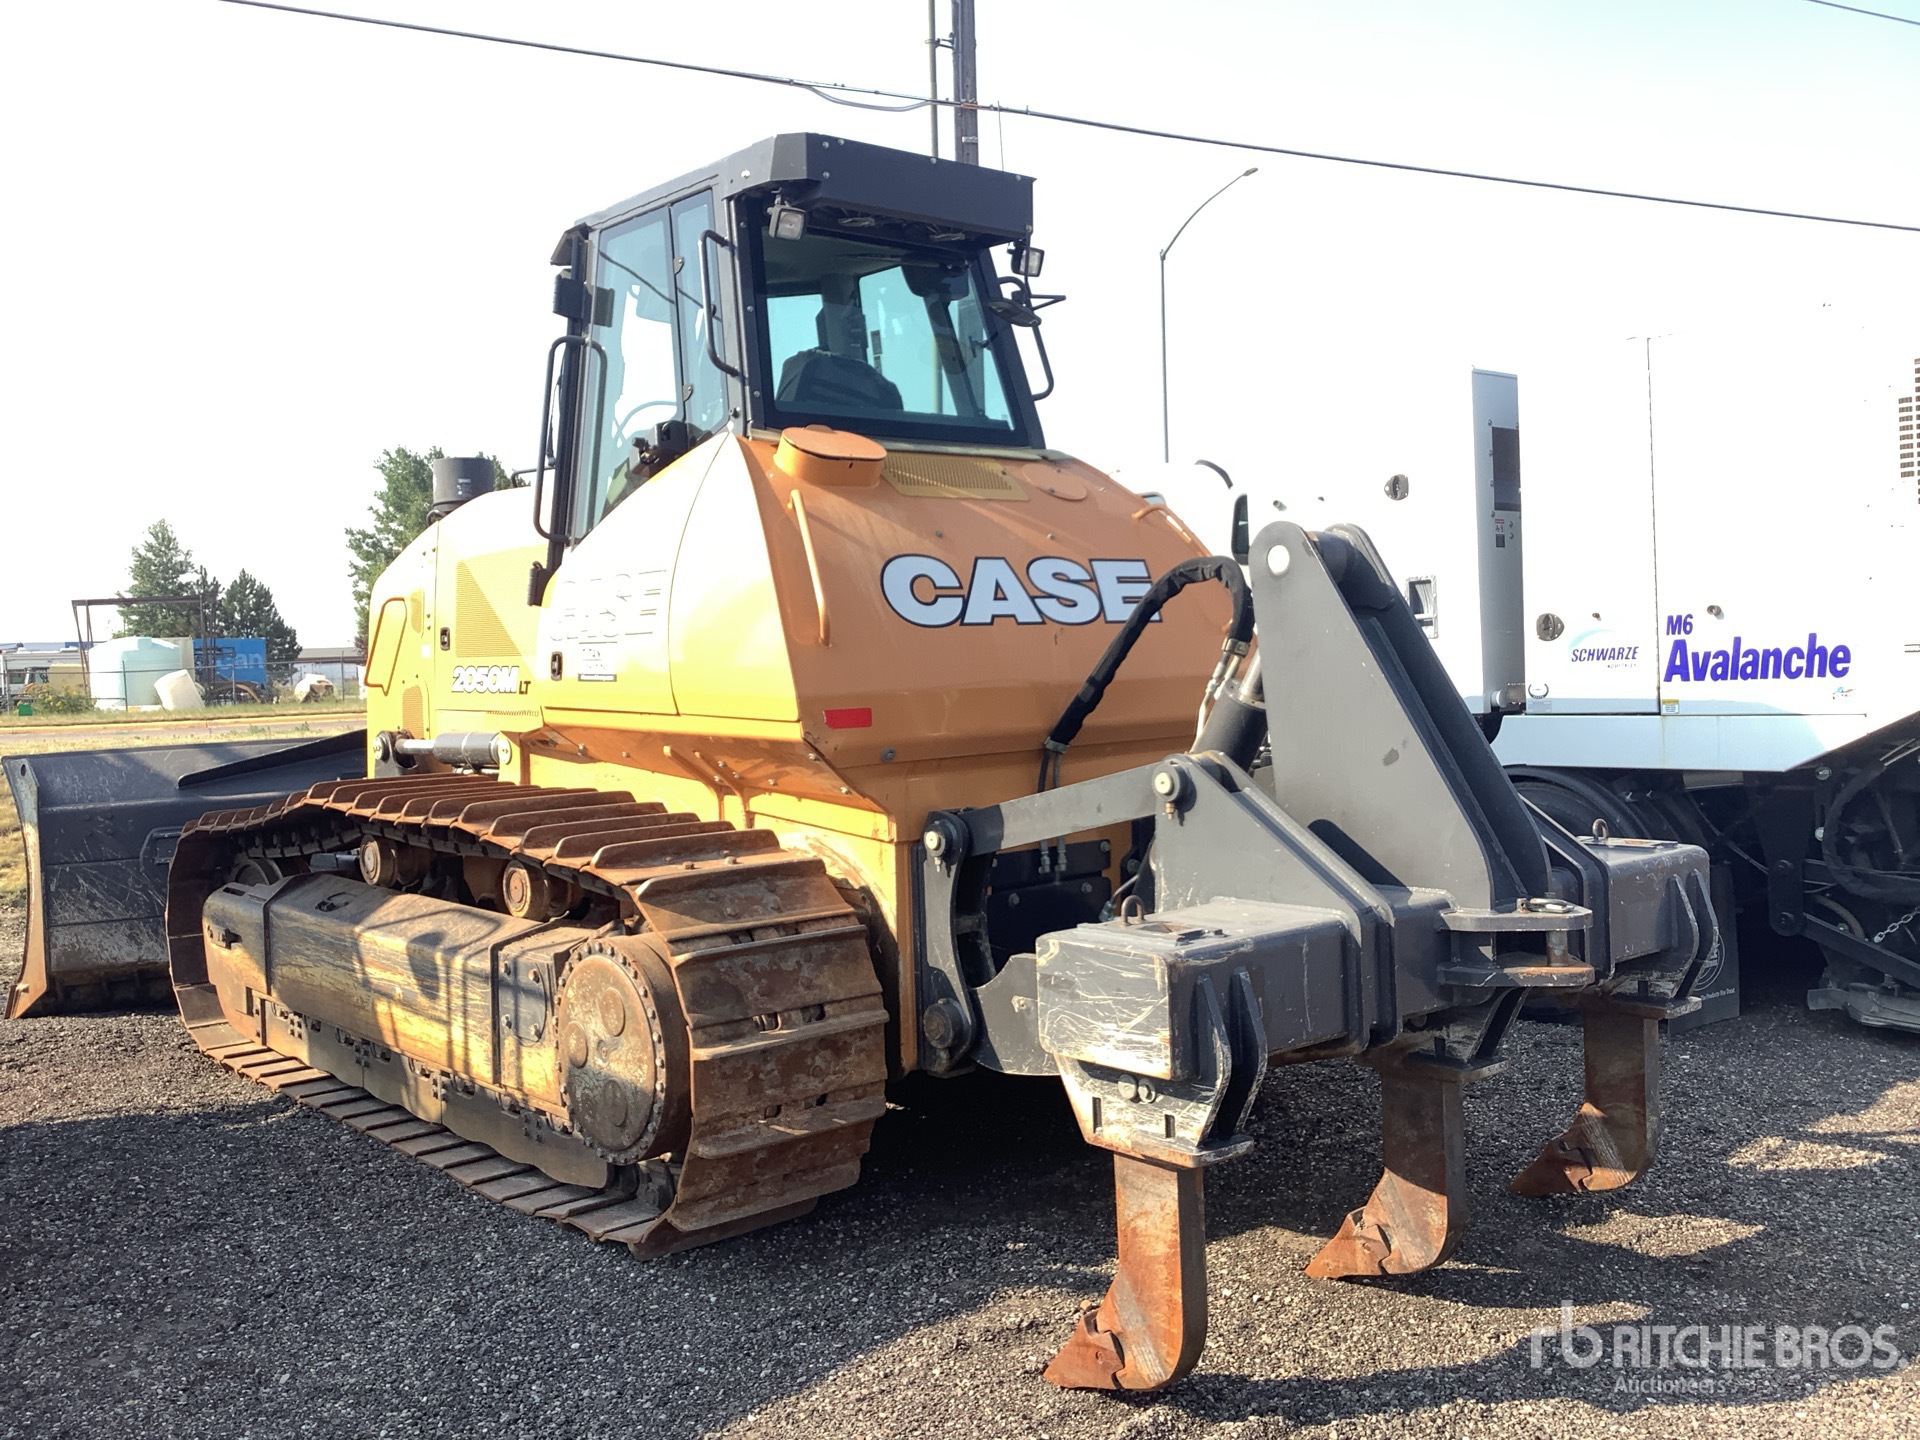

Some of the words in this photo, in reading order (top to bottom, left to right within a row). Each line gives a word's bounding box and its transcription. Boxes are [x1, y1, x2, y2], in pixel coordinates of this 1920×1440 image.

[880, 554, 1163, 628] CASE
[1667, 613, 1694, 636] M6
[1571, 646, 1640, 663] SCHWARZE
[1664, 633, 1852, 682] Avalanche
